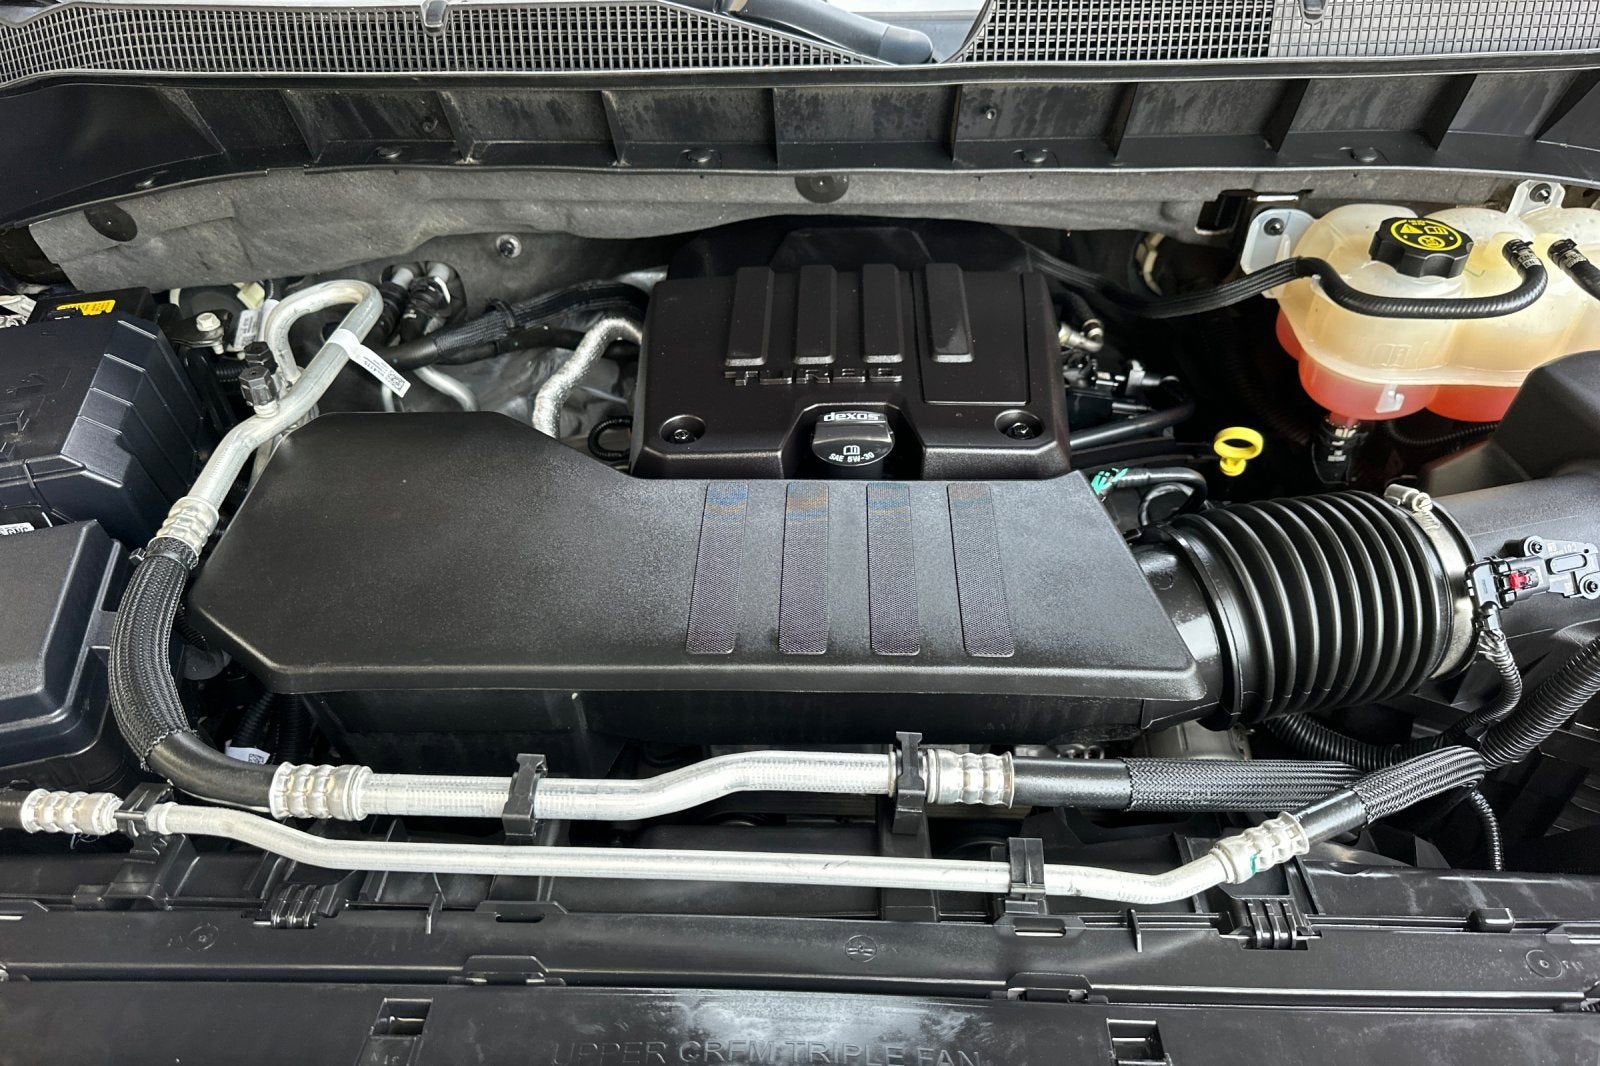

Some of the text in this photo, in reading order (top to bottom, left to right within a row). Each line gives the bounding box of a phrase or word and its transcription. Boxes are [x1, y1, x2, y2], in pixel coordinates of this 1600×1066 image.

[823, 412, 883, 422] dexos
[828, 451, 875, 463] SAE 5W-30
[551, 1041, 667, 1065] UPPER
[785, 1040, 905, 1066] TRIPLE
[917, 1047, 981, 1066] FAN
